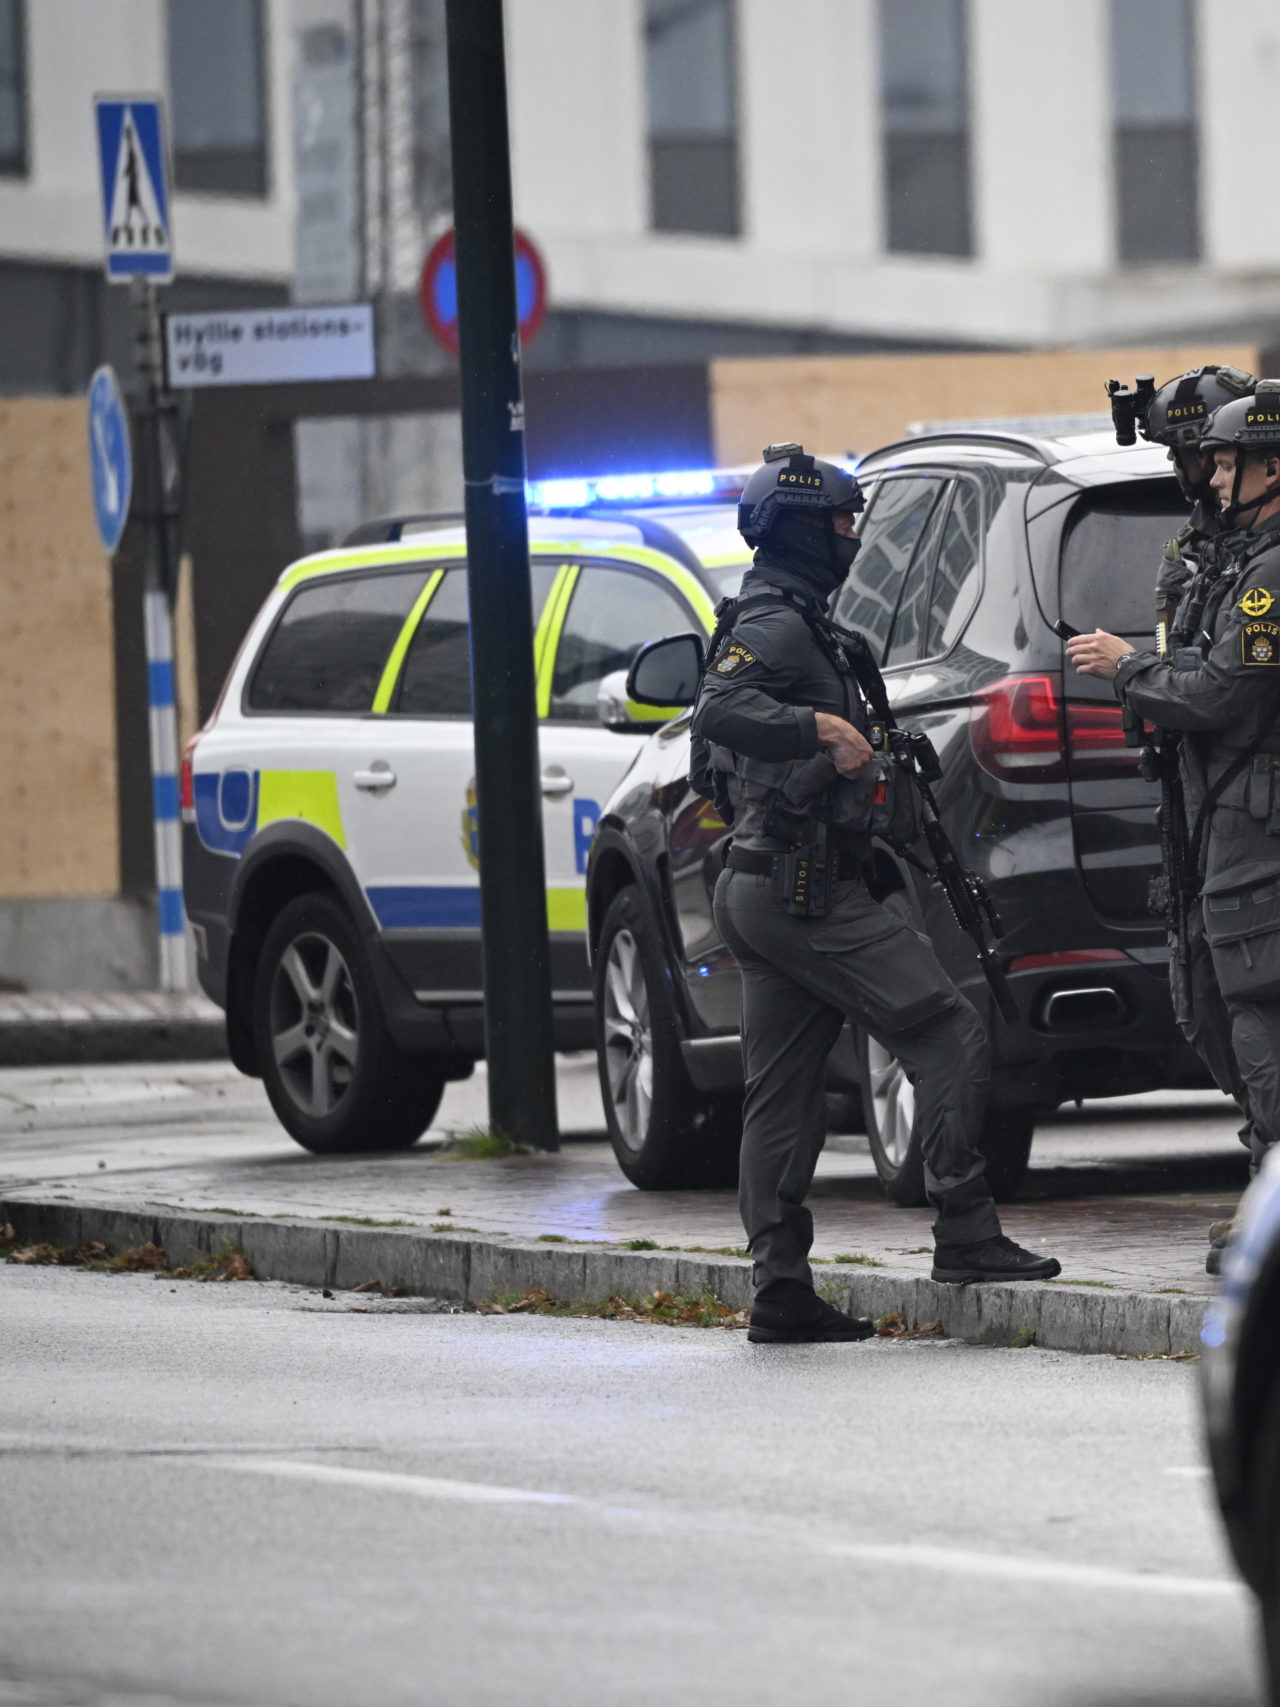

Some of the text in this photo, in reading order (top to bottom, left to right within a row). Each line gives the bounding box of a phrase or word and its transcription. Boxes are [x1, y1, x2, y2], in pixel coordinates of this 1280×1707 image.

[174, 317, 364, 346] Hyllie stations-
[1167, 405, 1204, 418] POLIS
[780, 474, 821, 486] POLIS
[1245, 624, 1279, 636] POLIS
[729, 646, 754, 662] POLIS
[795, 861, 808, 902] POLIS
